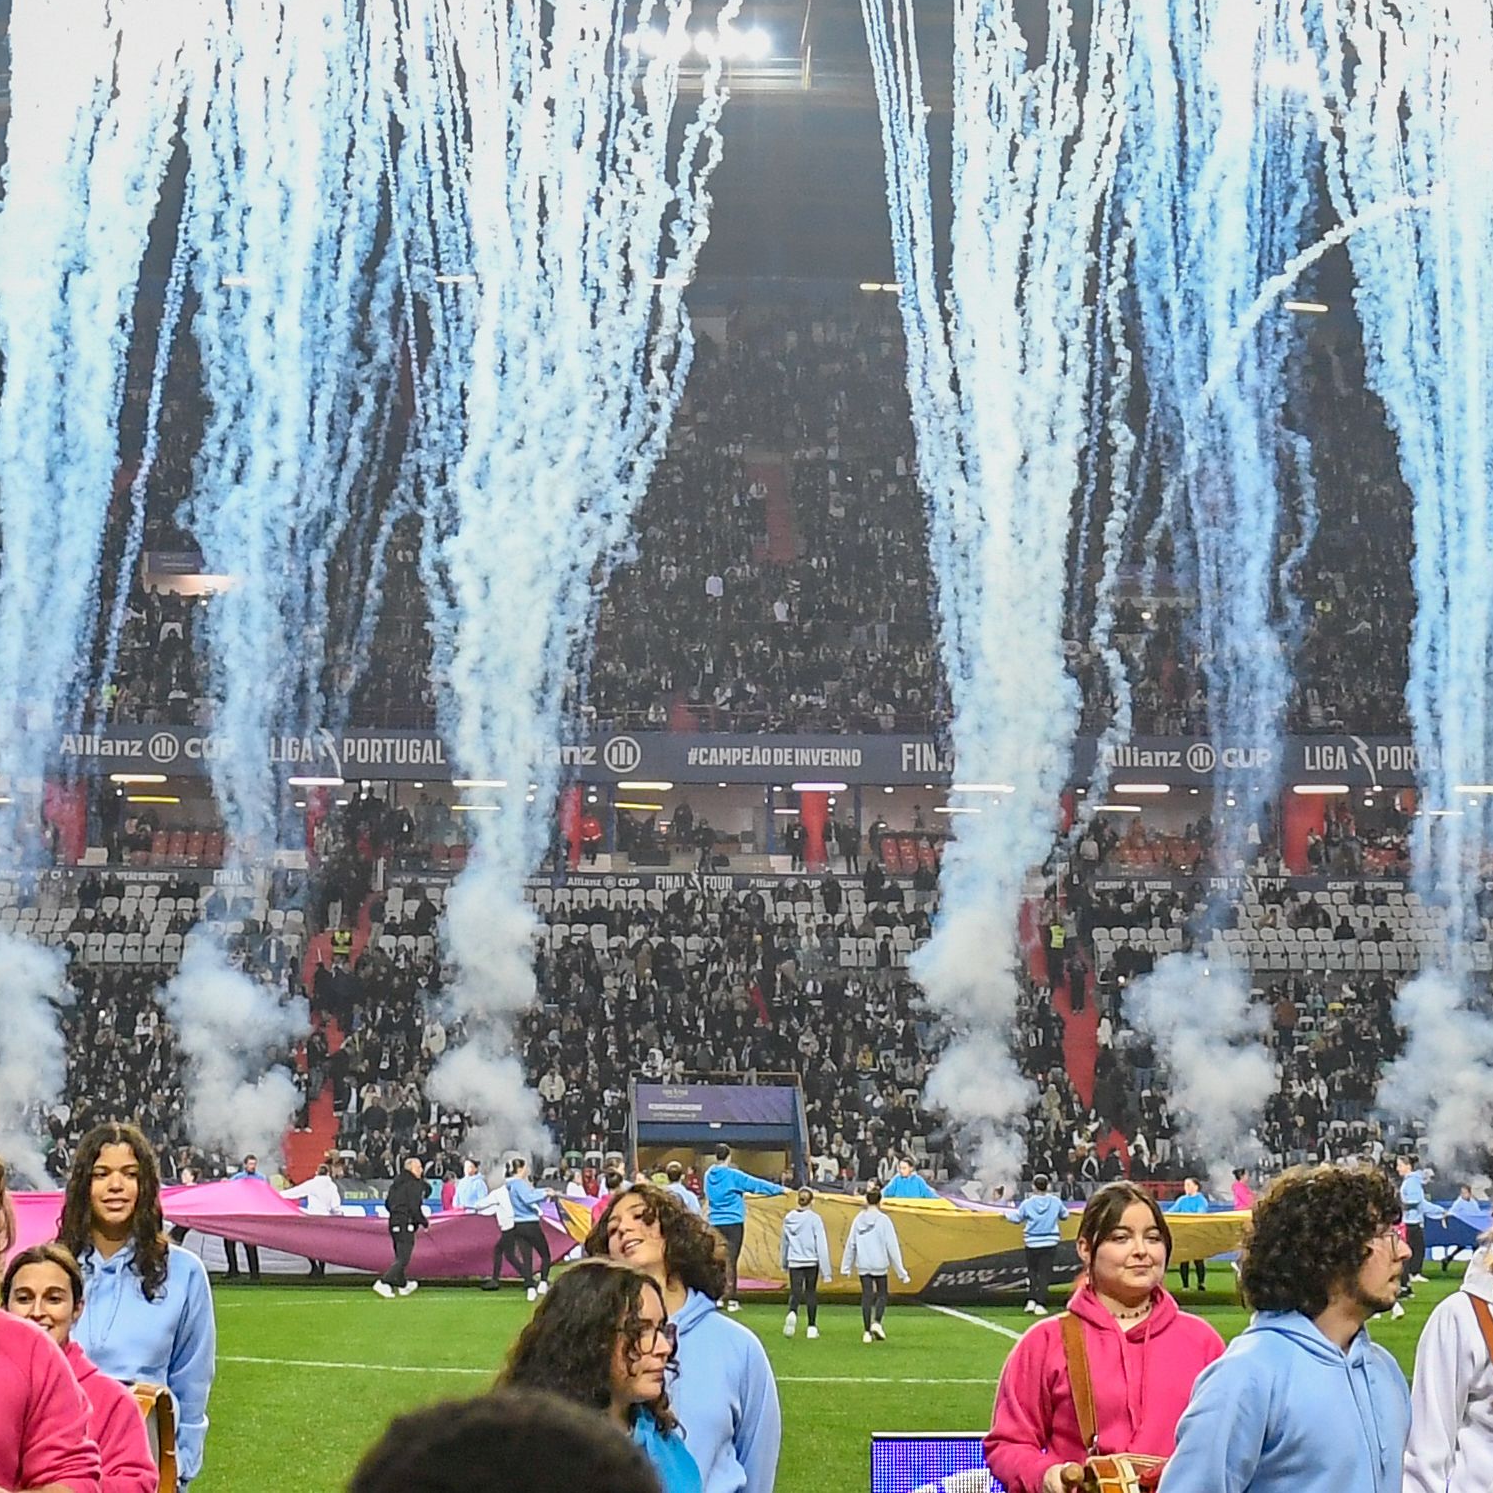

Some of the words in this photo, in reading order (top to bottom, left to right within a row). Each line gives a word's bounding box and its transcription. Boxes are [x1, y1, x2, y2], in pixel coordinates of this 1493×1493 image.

[59, 733, 144, 758] Allianz
[270, 737, 314, 763] LIGA
[343, 737, 446, 765] PORTUGAL
[1106, 746, 1182, 768] Allianz
[1222, 747, 1273, 769] CUP
[1304, 745, 1349, 771] LIGA
[566, 877, 601, 887] Allianz
[617, 878, 640, 888] CUP
[703, 876, 733, 891] FOUR
[748, 878, 779, 888] Allian
